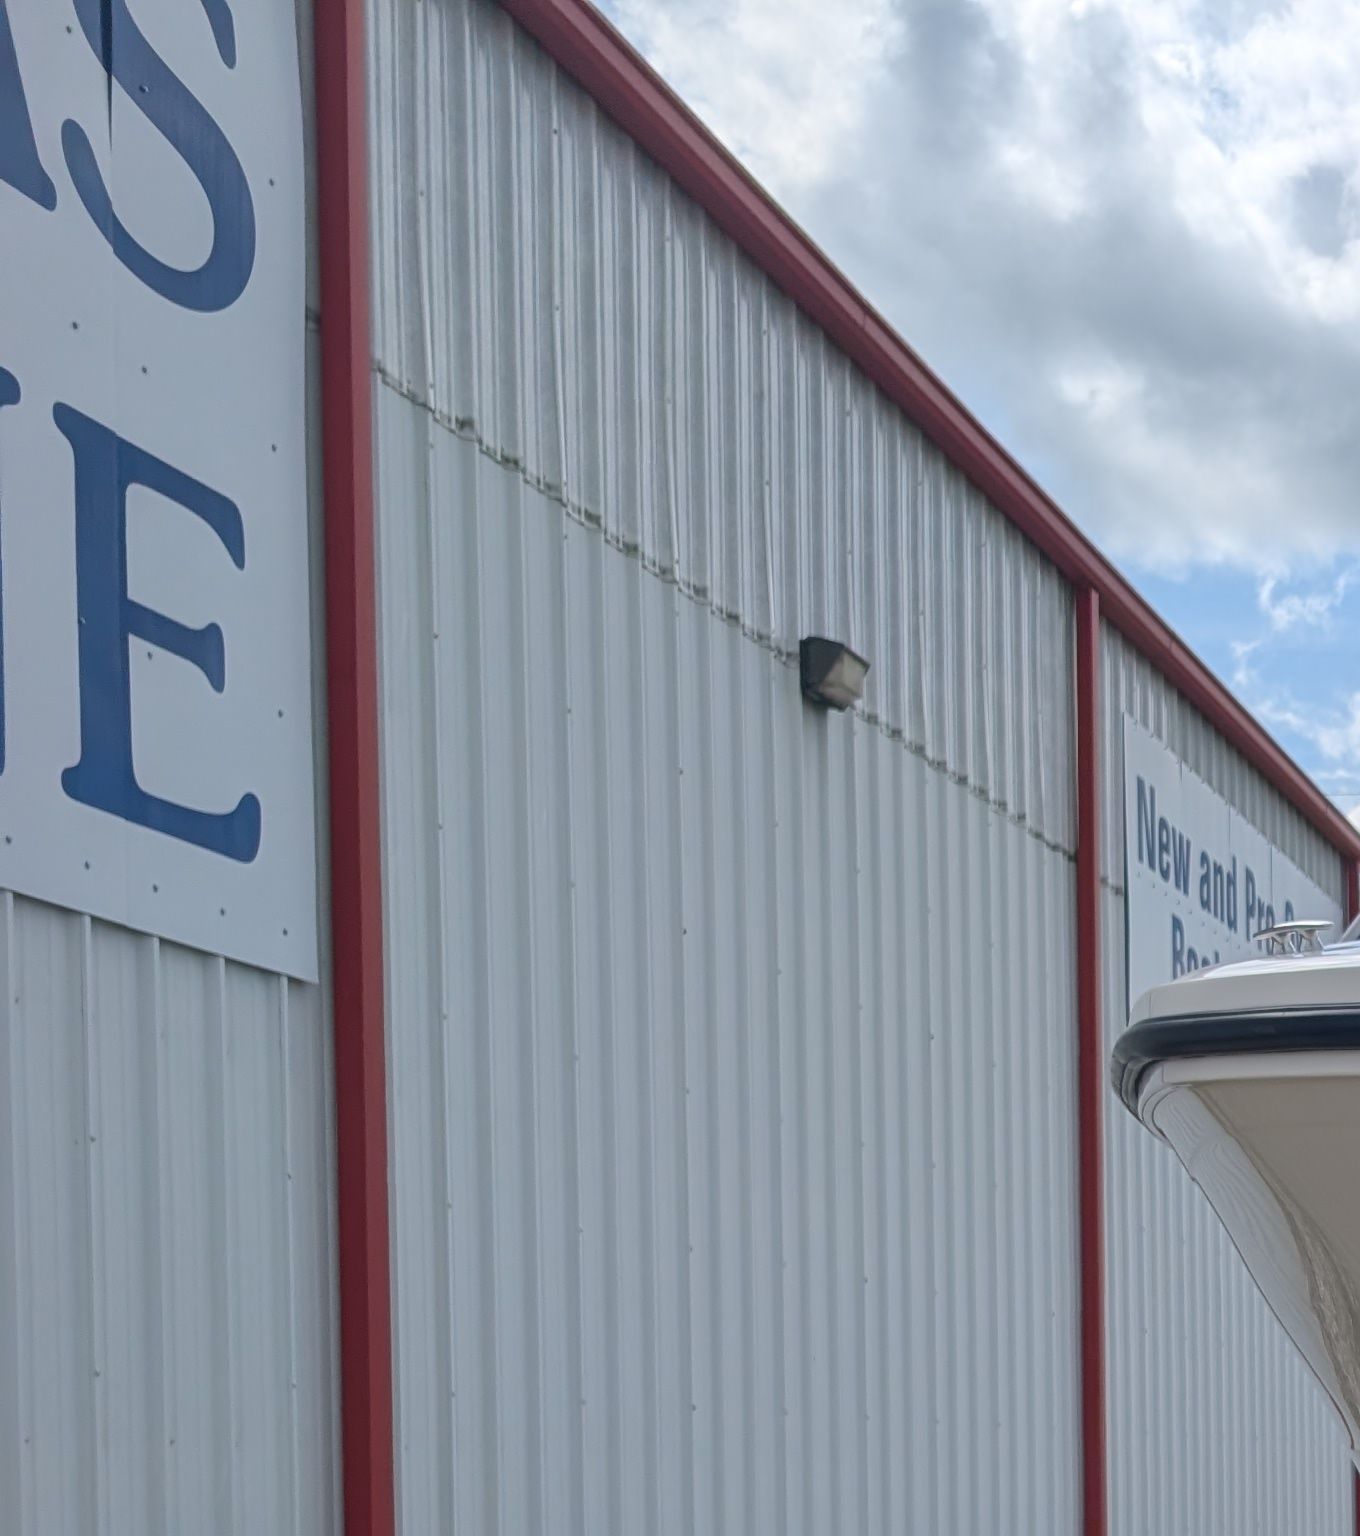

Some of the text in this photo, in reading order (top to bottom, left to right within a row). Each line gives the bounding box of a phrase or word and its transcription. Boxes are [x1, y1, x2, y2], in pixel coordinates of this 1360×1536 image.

[0, 366, 261, 864] E
[1137, 775, 1191, 897] New
[1200, 850, 1238, 934] and
